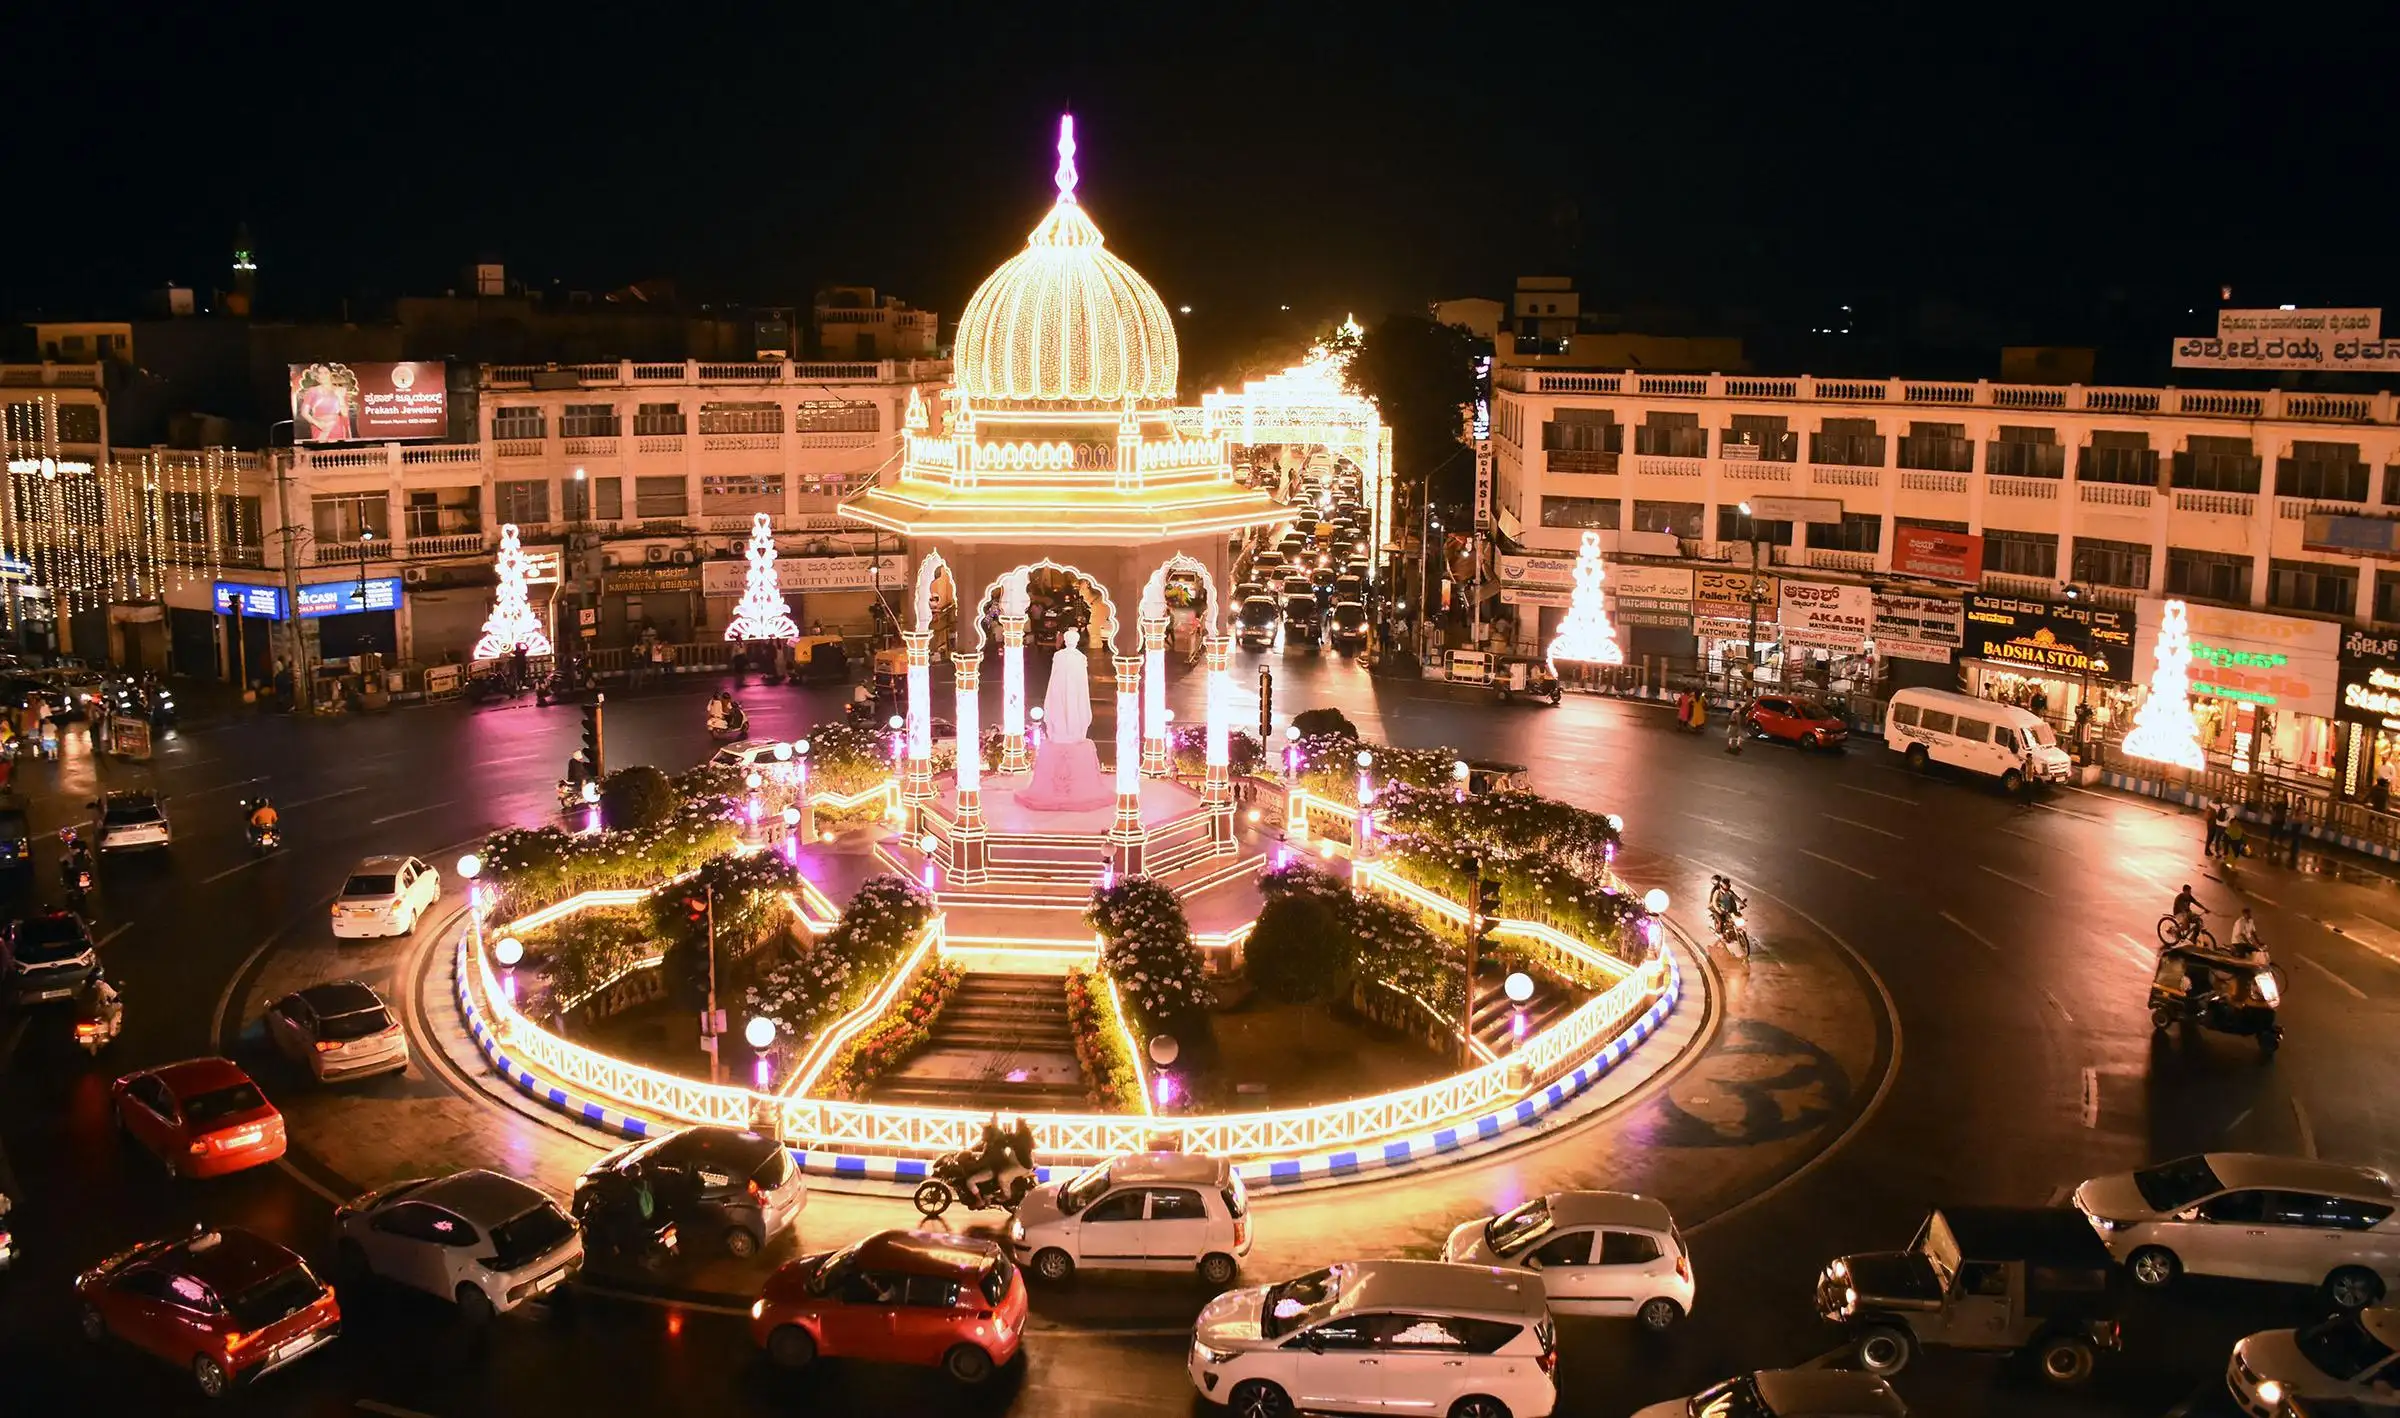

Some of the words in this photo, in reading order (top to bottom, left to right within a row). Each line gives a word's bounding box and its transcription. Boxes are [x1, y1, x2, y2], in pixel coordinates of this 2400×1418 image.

[365, 406, 399, 415] Prakash
[401, 406, 442, 414] Jewellers
[608, 582, 657, 592] NAVARATNA
[787, 576, 829, 586] CHETTY
[309, 593, 338, 603] CASH
[1620, 598, 1657, 609] MATCHING
[1659, 601, 1689, 611] CENTRE
[1706, 602, 1729, 610] FANCY
[1620, 612, 1658, 624] MATCHING
[1659, 615, 1689, 627] CENTER
[1809, 612, 1866, 626] AKASH
[1703, 620, 1730, 628] FANCY
[1736, 623, 1770, 631] SARES
[1809, 622, 1840, 631] MATCHING
[1841, 625, 1865, 634] CENTRE
[1699, 628, 1737, 638] MATCHING
[1742, 632, 1772, 641] CETRE
[1788, 640, 1827, 650] MATCHING
[1828, 644, 1857, 653] CENTRE
[1983, 641, 2045, 663] BADSHA
